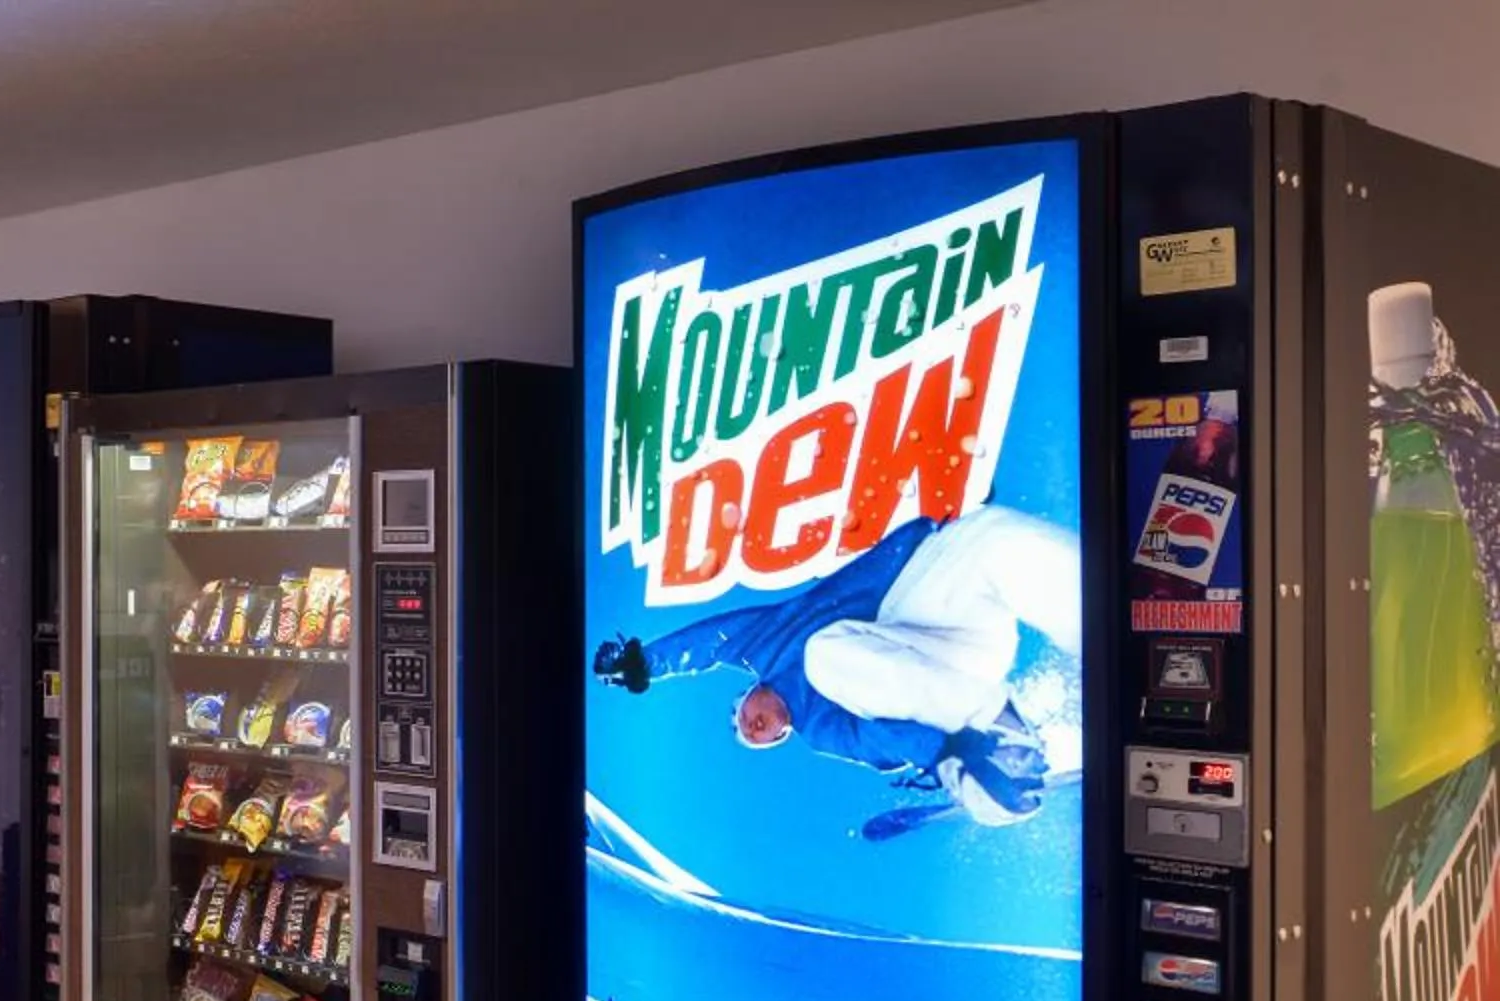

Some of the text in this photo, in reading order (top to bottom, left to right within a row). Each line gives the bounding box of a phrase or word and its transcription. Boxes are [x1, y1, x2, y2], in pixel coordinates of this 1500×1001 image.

[1129, 397, 1199, 427] 20
[1130, 426, 1197, 440] OUNCES
[1161, 483, 1228, 517] PEPSI
[1131, 601, 1243, 632] REFRESHMENT
